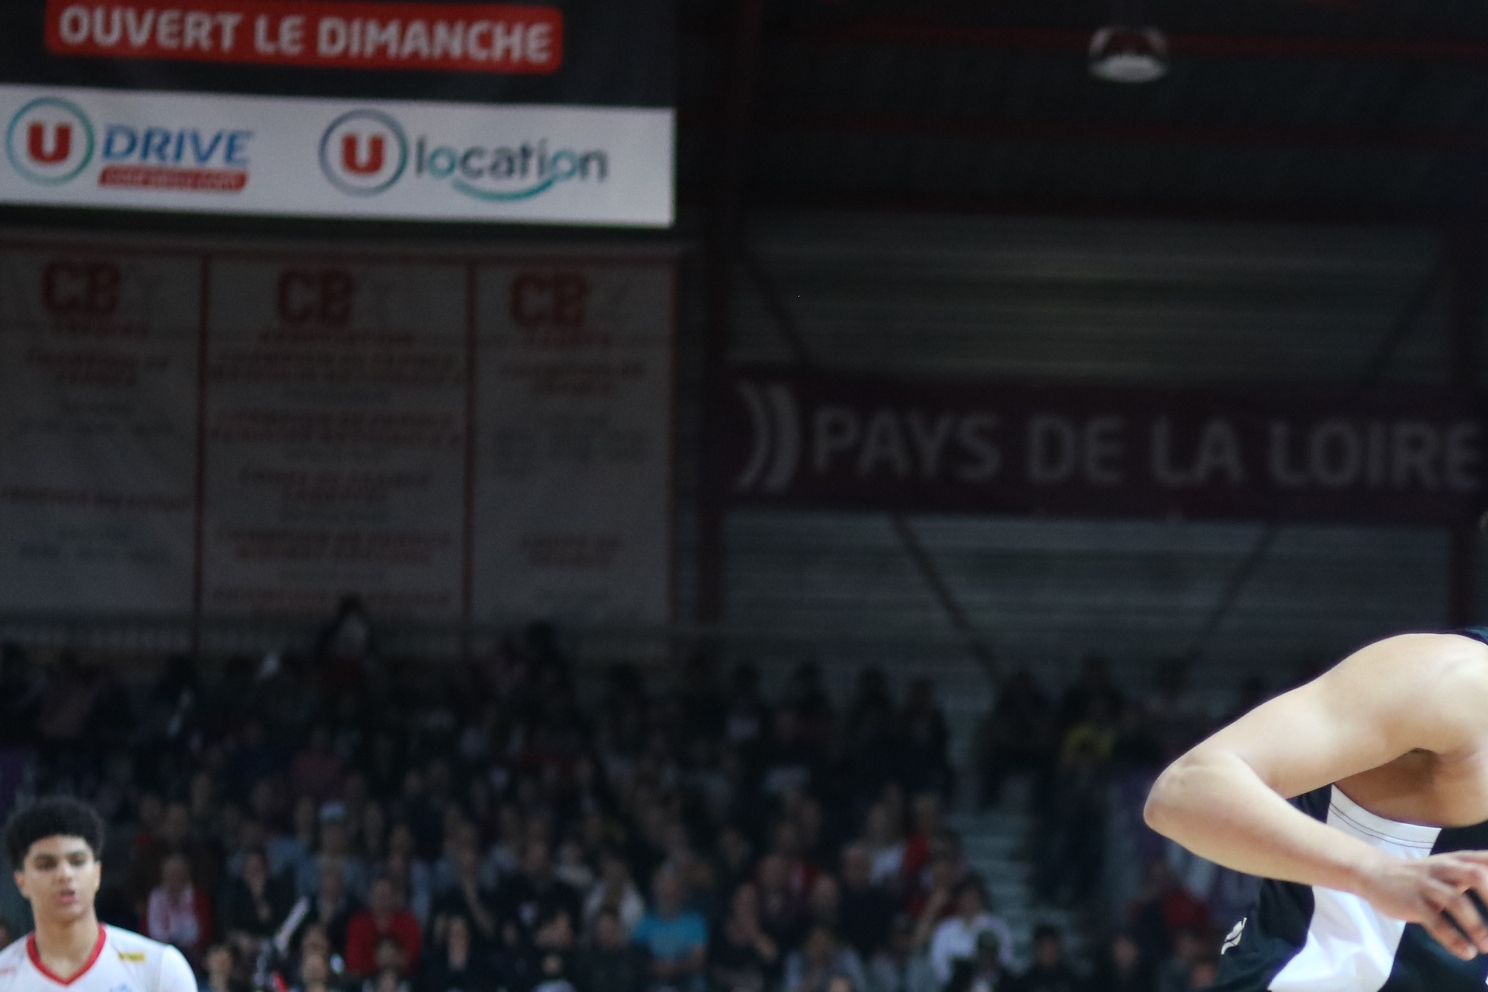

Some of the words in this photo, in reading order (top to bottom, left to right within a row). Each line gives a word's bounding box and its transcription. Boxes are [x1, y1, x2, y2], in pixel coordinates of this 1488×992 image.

[57, 5, 243, 54] OUVERT
[254, 14, 307, 57] LE
[316, 17, 553, 65] DIMANCHE
[27, 122, 72, 164] U
[101, 124, 253, 166] DRIVE
[341, 132, 386, 175] U
[415, 137, 609, 181] location
[810, 405, 1004, 482] PAYS
[1026, 415, 1124, 485] DE
[1150, 415, 1244, 486] LA
[1267, 419, 1482, 491] LOIRE
